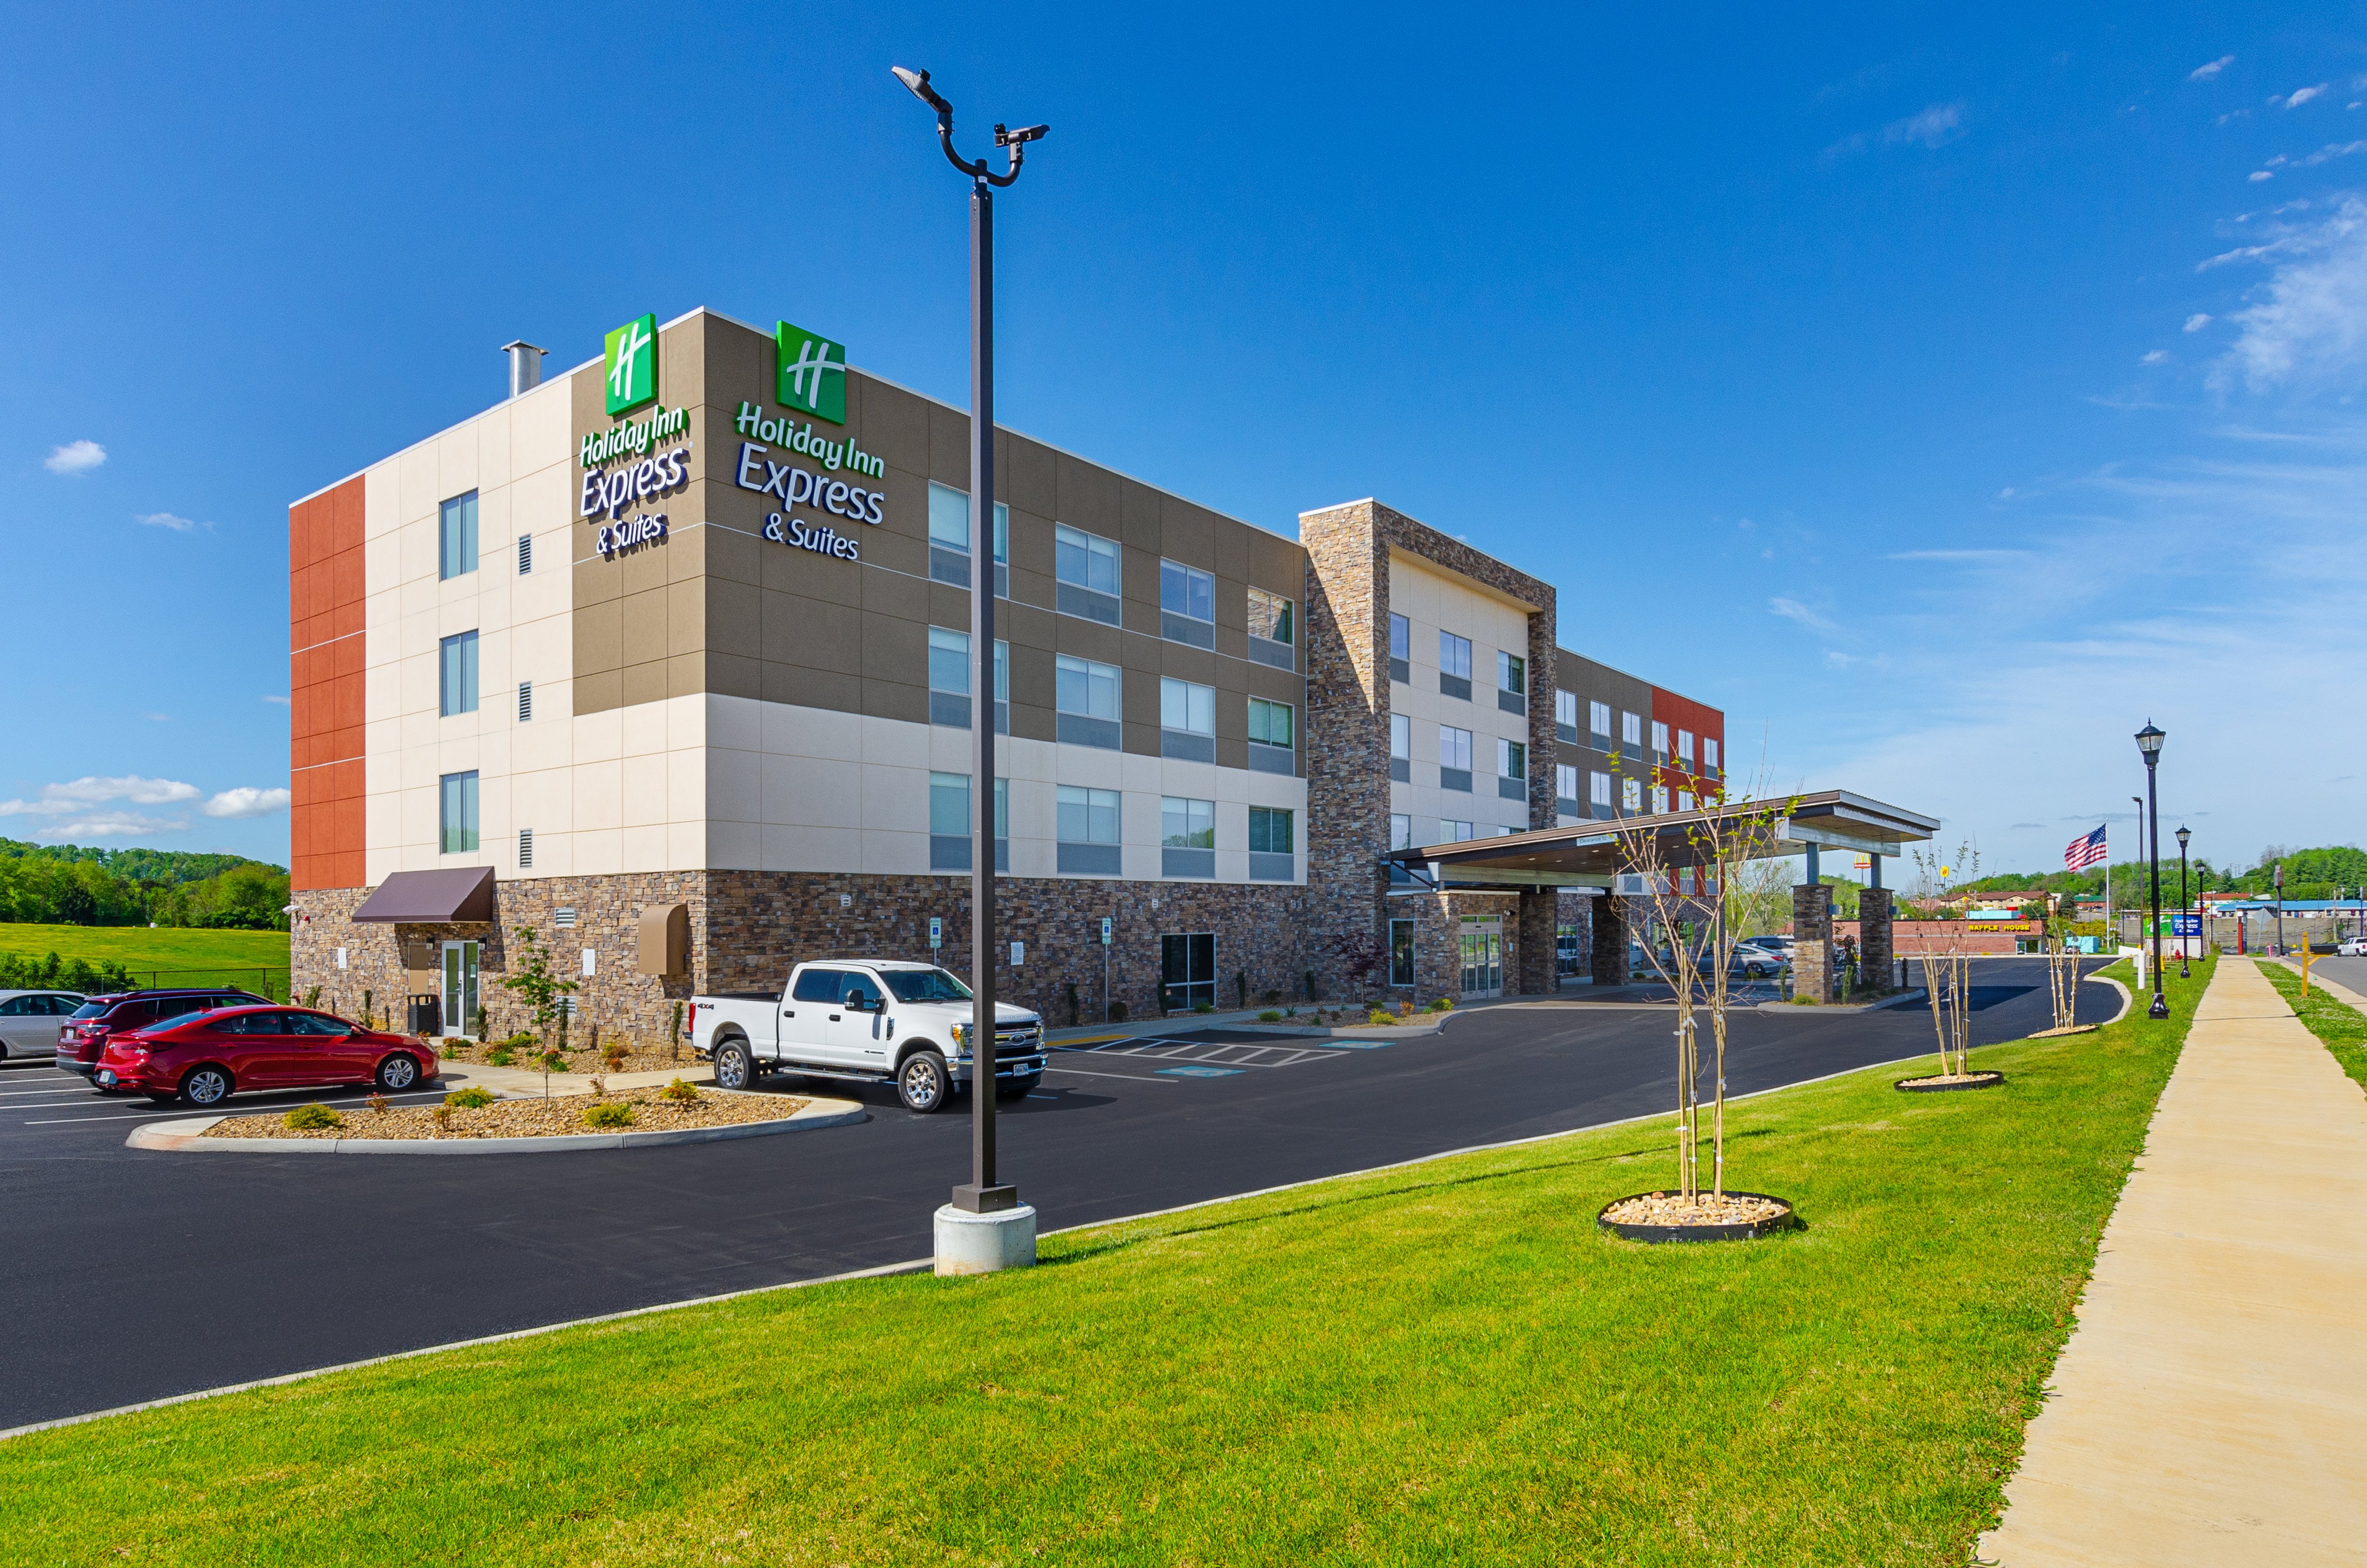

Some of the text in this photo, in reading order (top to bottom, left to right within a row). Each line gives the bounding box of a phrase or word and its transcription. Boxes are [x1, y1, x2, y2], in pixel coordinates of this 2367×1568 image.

[579, 405, 683, 467] Holiday Inn
[736, 401, 885, 479] Holiday Inn
[580, 448, 683, 519] Express
[738, 442, 884, 525] Express
[596, 513, 661, 554] & Suites
[766, 513, 859, 560] & Suites
